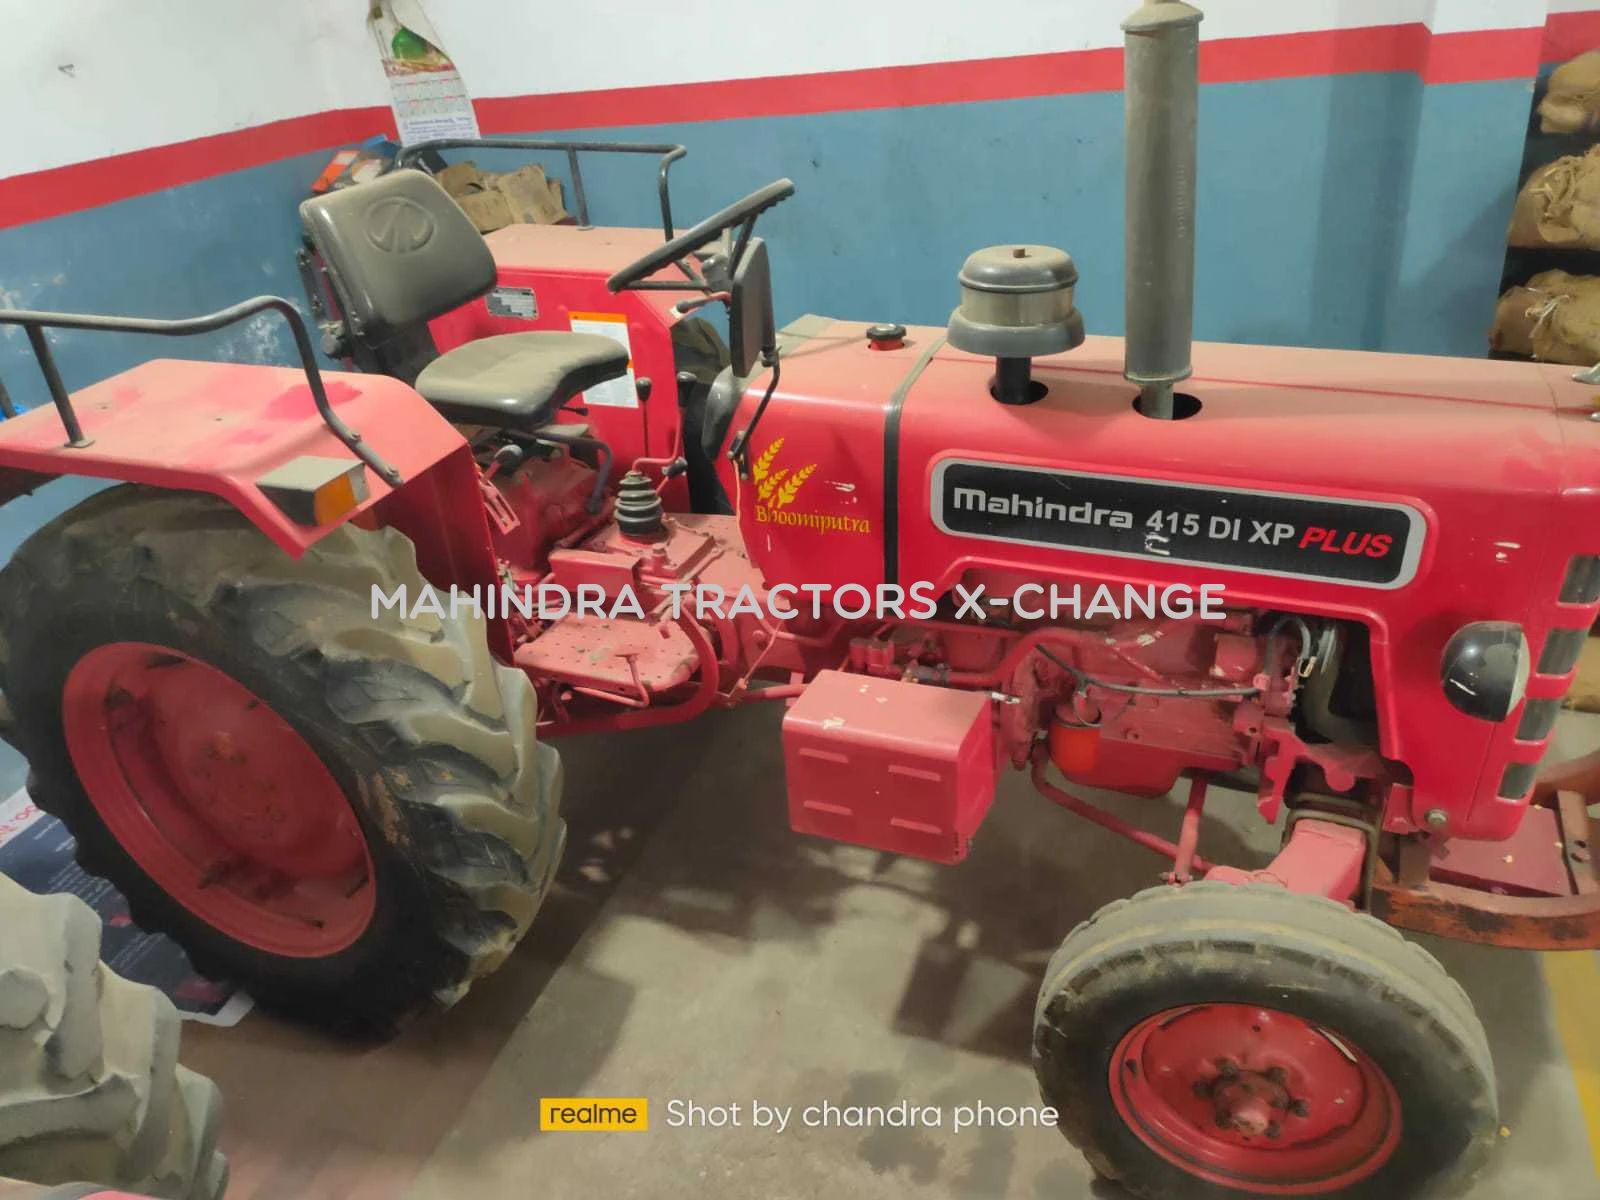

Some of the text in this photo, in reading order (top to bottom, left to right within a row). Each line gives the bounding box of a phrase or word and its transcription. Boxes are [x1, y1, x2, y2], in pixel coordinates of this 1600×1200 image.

[755, 504, 872, 535] Bhoomiputra
[1145, 510, 1200, 536] 415
[1208, 516, 1242, 541] DI
[1248, 520, 1296, 546] XP
[1298, 527, 1393, 558] PLUS
